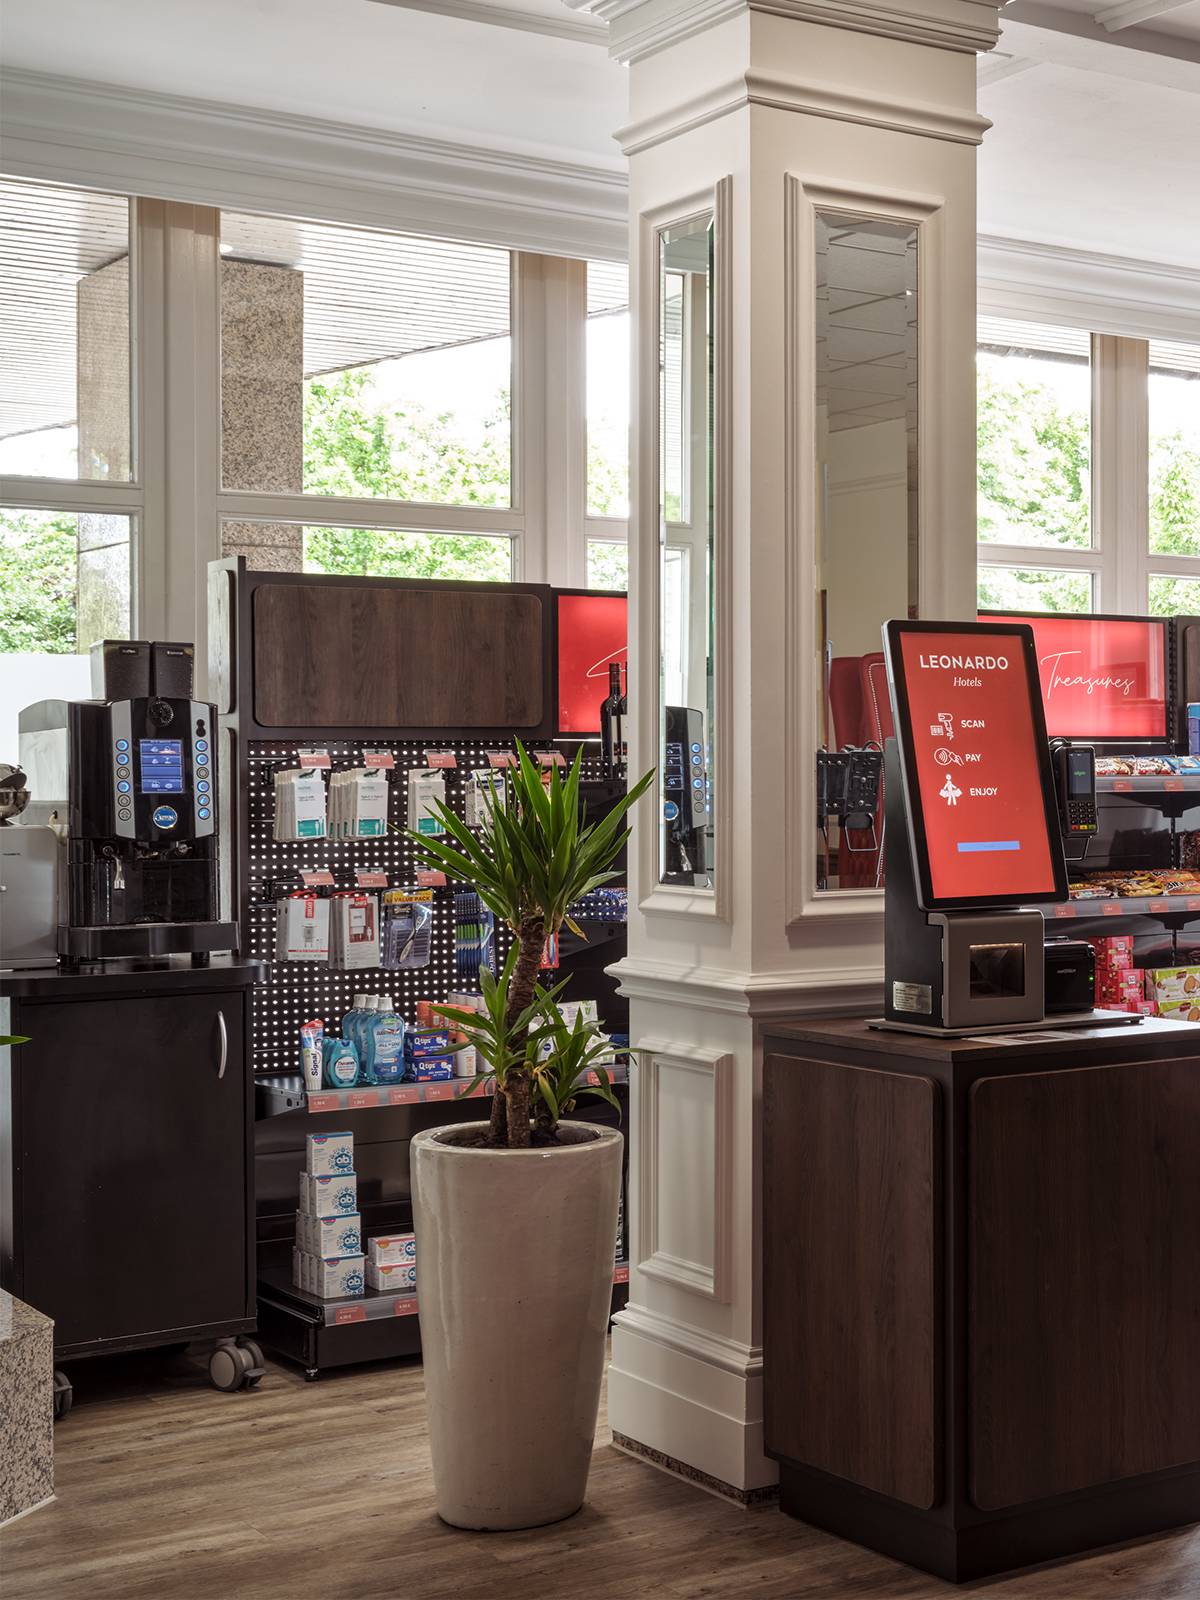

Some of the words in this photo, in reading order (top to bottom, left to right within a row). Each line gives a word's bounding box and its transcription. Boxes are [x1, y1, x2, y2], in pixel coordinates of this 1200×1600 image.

[919, 654, 1009, 670] LEONARDO
[1040, 650, 1135, 700] Treasures
[953, 677, 982, 687] Hotels
[961, 719, 985, 728] SCAN
[965, 753, 981, 762] PAY
[969, 787, 998, 796] ENJOY
